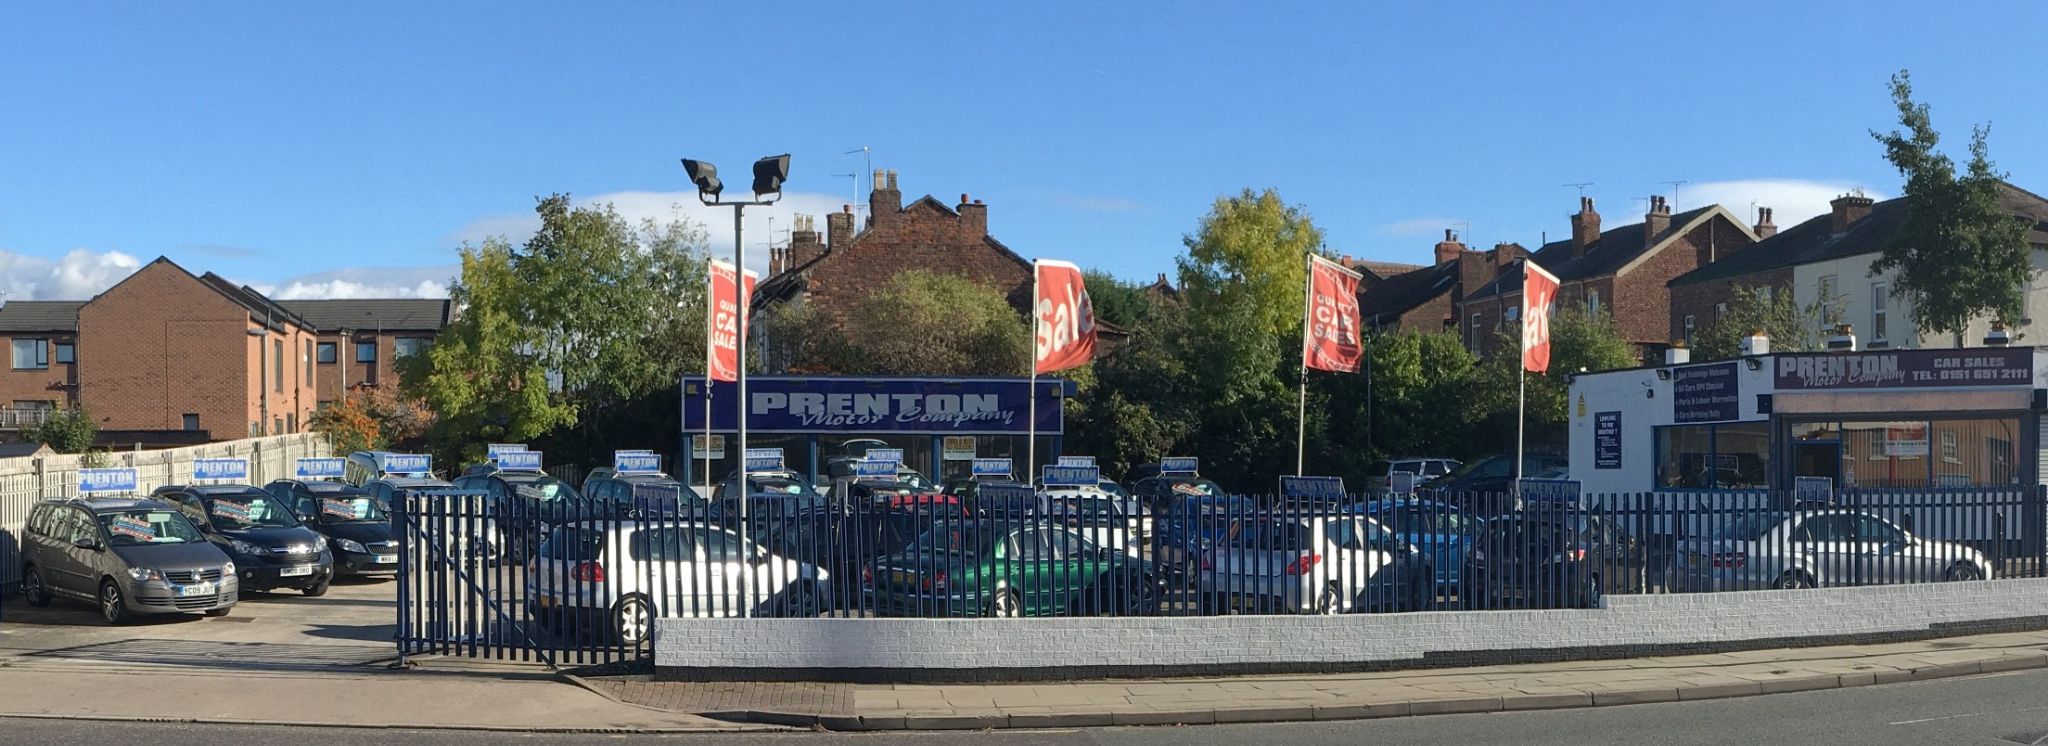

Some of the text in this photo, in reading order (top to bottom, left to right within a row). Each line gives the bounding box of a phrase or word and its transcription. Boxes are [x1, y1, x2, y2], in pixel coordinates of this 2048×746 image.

[714, 330, 737, 351] SALE
[1780, 355, 1898, 378] PRENTON
[1934, 356, 2005, 368] CAR SALES
[1802, 367, 1906, 388] Motor Company
[1912, 368, 2028, 381] TEL: 0151 651 2111
[751, 392, 999, 416] PRENTON
[796, 406, 1016, 428] Motor Company
[386, 455, 430, 466] PRENTON
[500, 454, 539, 464] PRENTON
[619, 457, 658, 467] PRENTON
[974, 460, 1009, 469] PRENTON
[1163, 460, 1196, 469] PRENTON
[195, 462, 245, 473] PRENTON
[297, 461, 342, 472] PRENTON
[859, 462, 896, 472] PRENTON
[79, 471, 133, 485] PRENTON
[1046, 467, 1098, 480] PRENTON
[1284, 479, 1340, 494] PRENTON
[1521, 482, 1579, 494] PRENTON
[184, 585, 214, 595] YC09 JUT
